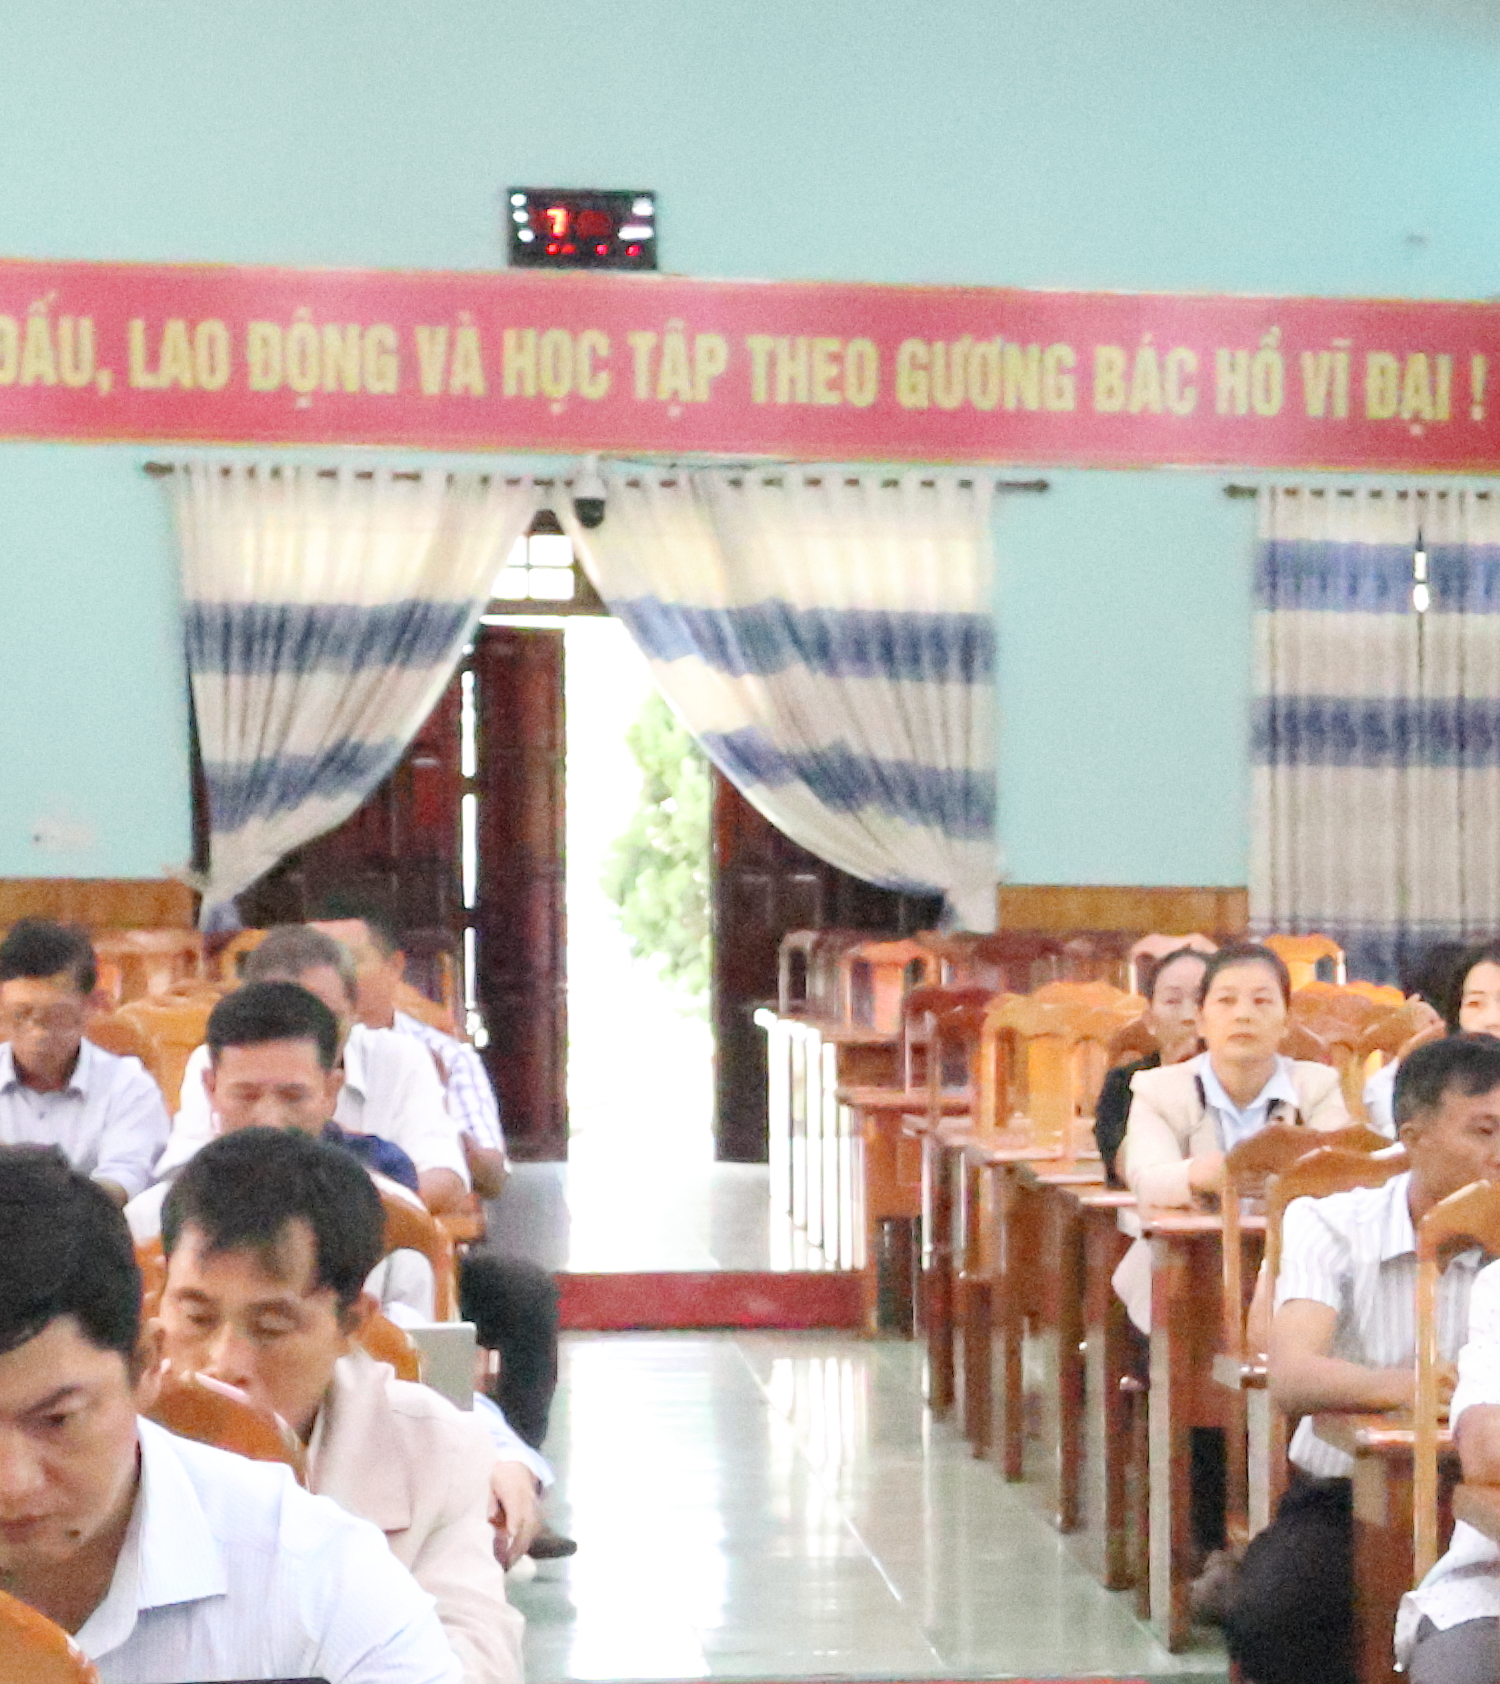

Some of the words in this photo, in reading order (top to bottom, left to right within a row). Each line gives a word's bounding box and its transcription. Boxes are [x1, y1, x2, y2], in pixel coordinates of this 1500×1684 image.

[128, 318, 231, 391] LAO
[247, 307, 399, 411] ĐỘNG
[414, 312, 488, 397] VÀ
[503, 328, 611, 415] HỌC
[628, 318, 728, 419] TẬP
[745, 335, 880, 408] THEO
[895, 333, 1077, 413] GƯƠNG
[1092, 332, 1198, 416] BÁC
[1215, 325, 1286, 417] HỒ
[1301, 338, 1351, 420] VĨ
[1364, 351, 1453, 436] ĐẠI
[1471, 354, 1487, 422] !
